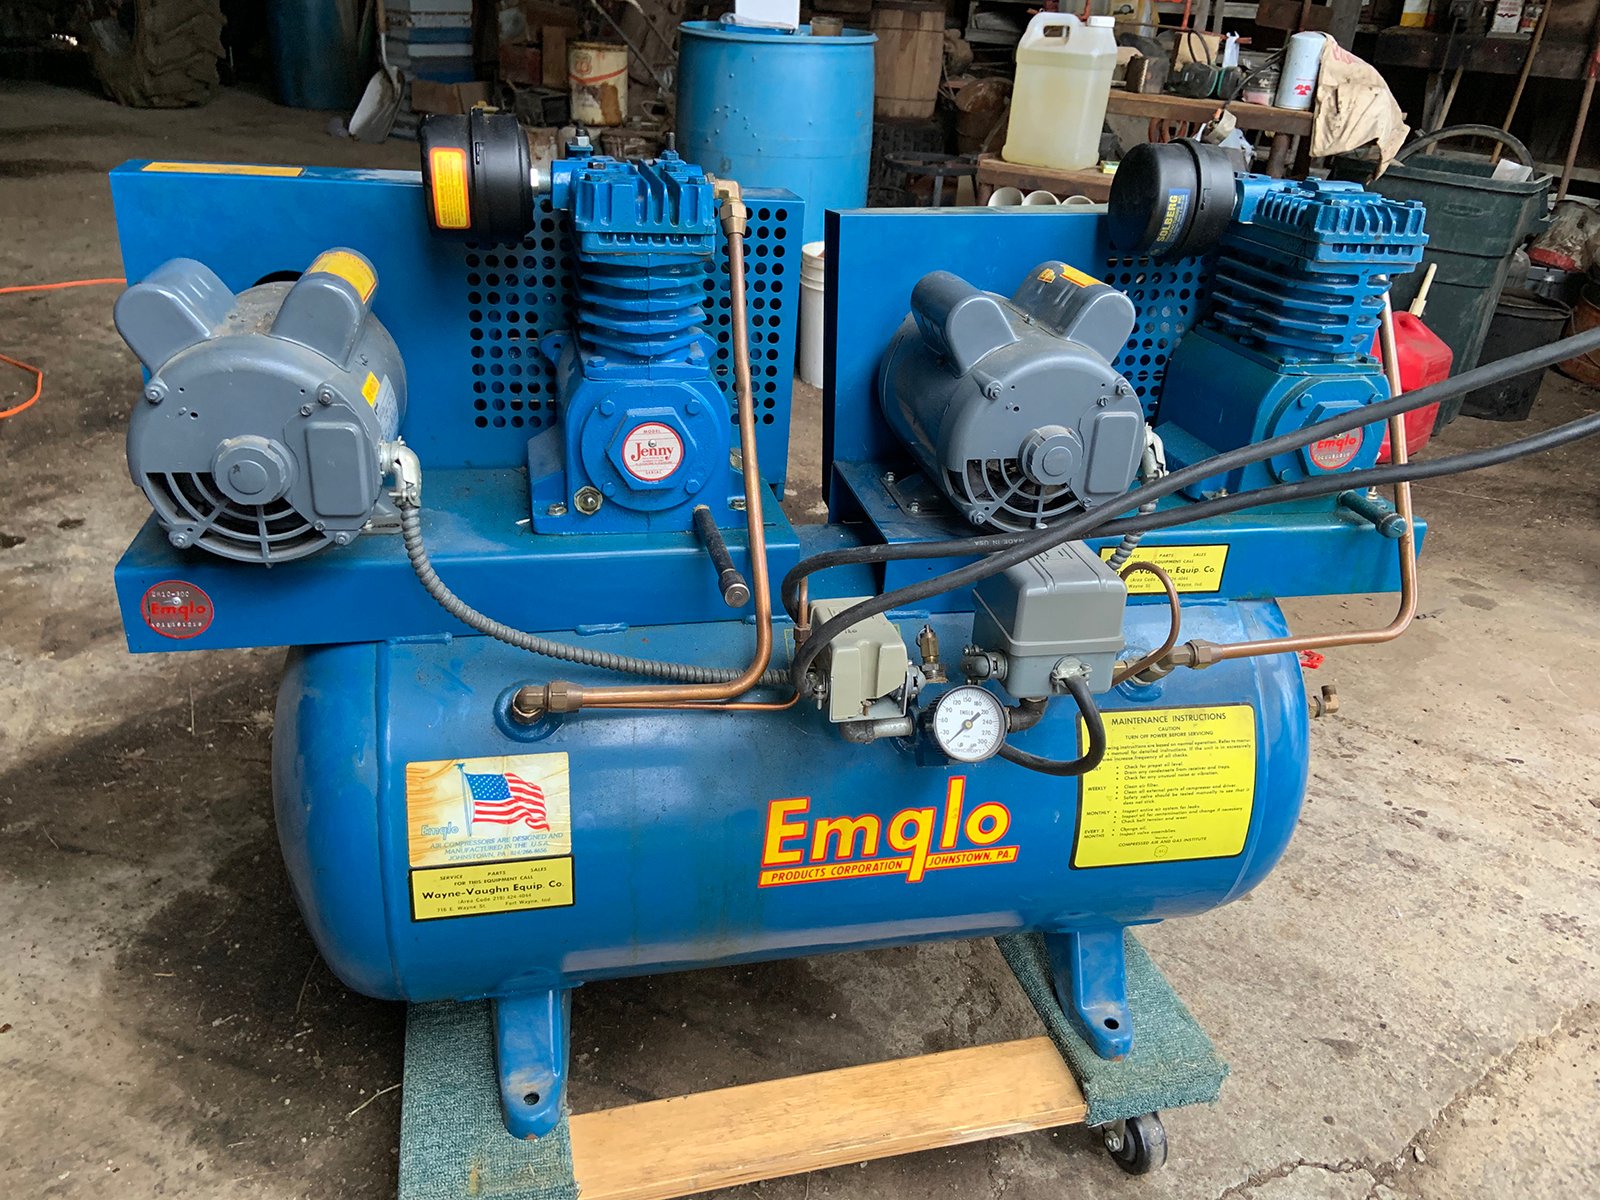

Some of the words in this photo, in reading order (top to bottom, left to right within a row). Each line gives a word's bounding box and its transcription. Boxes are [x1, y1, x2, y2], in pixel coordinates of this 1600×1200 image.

[1156, 195, 1178, 242] SOLBERG
[631, 442, 674, 462] Jenny
[1111, 716, 1168, 726] MAINTENANCE
[1172, 712, 1226, 722] INSTRUCTIONS
[444, 838, 495, 848] COMPRESSORS
[445, 844, 503, 855] MANUFACTURED
[771, 868, 825, 882] PRODUCTS
[831, 860, 902, 876] CORPORATION
[928, 852, 992, 866] JOHNSTOWN,
[996, 850, 1012, 859] PA.
[422, 886, 509, 899] Wayne-Vaughn
[513, 882, 545, 891] Equip.
